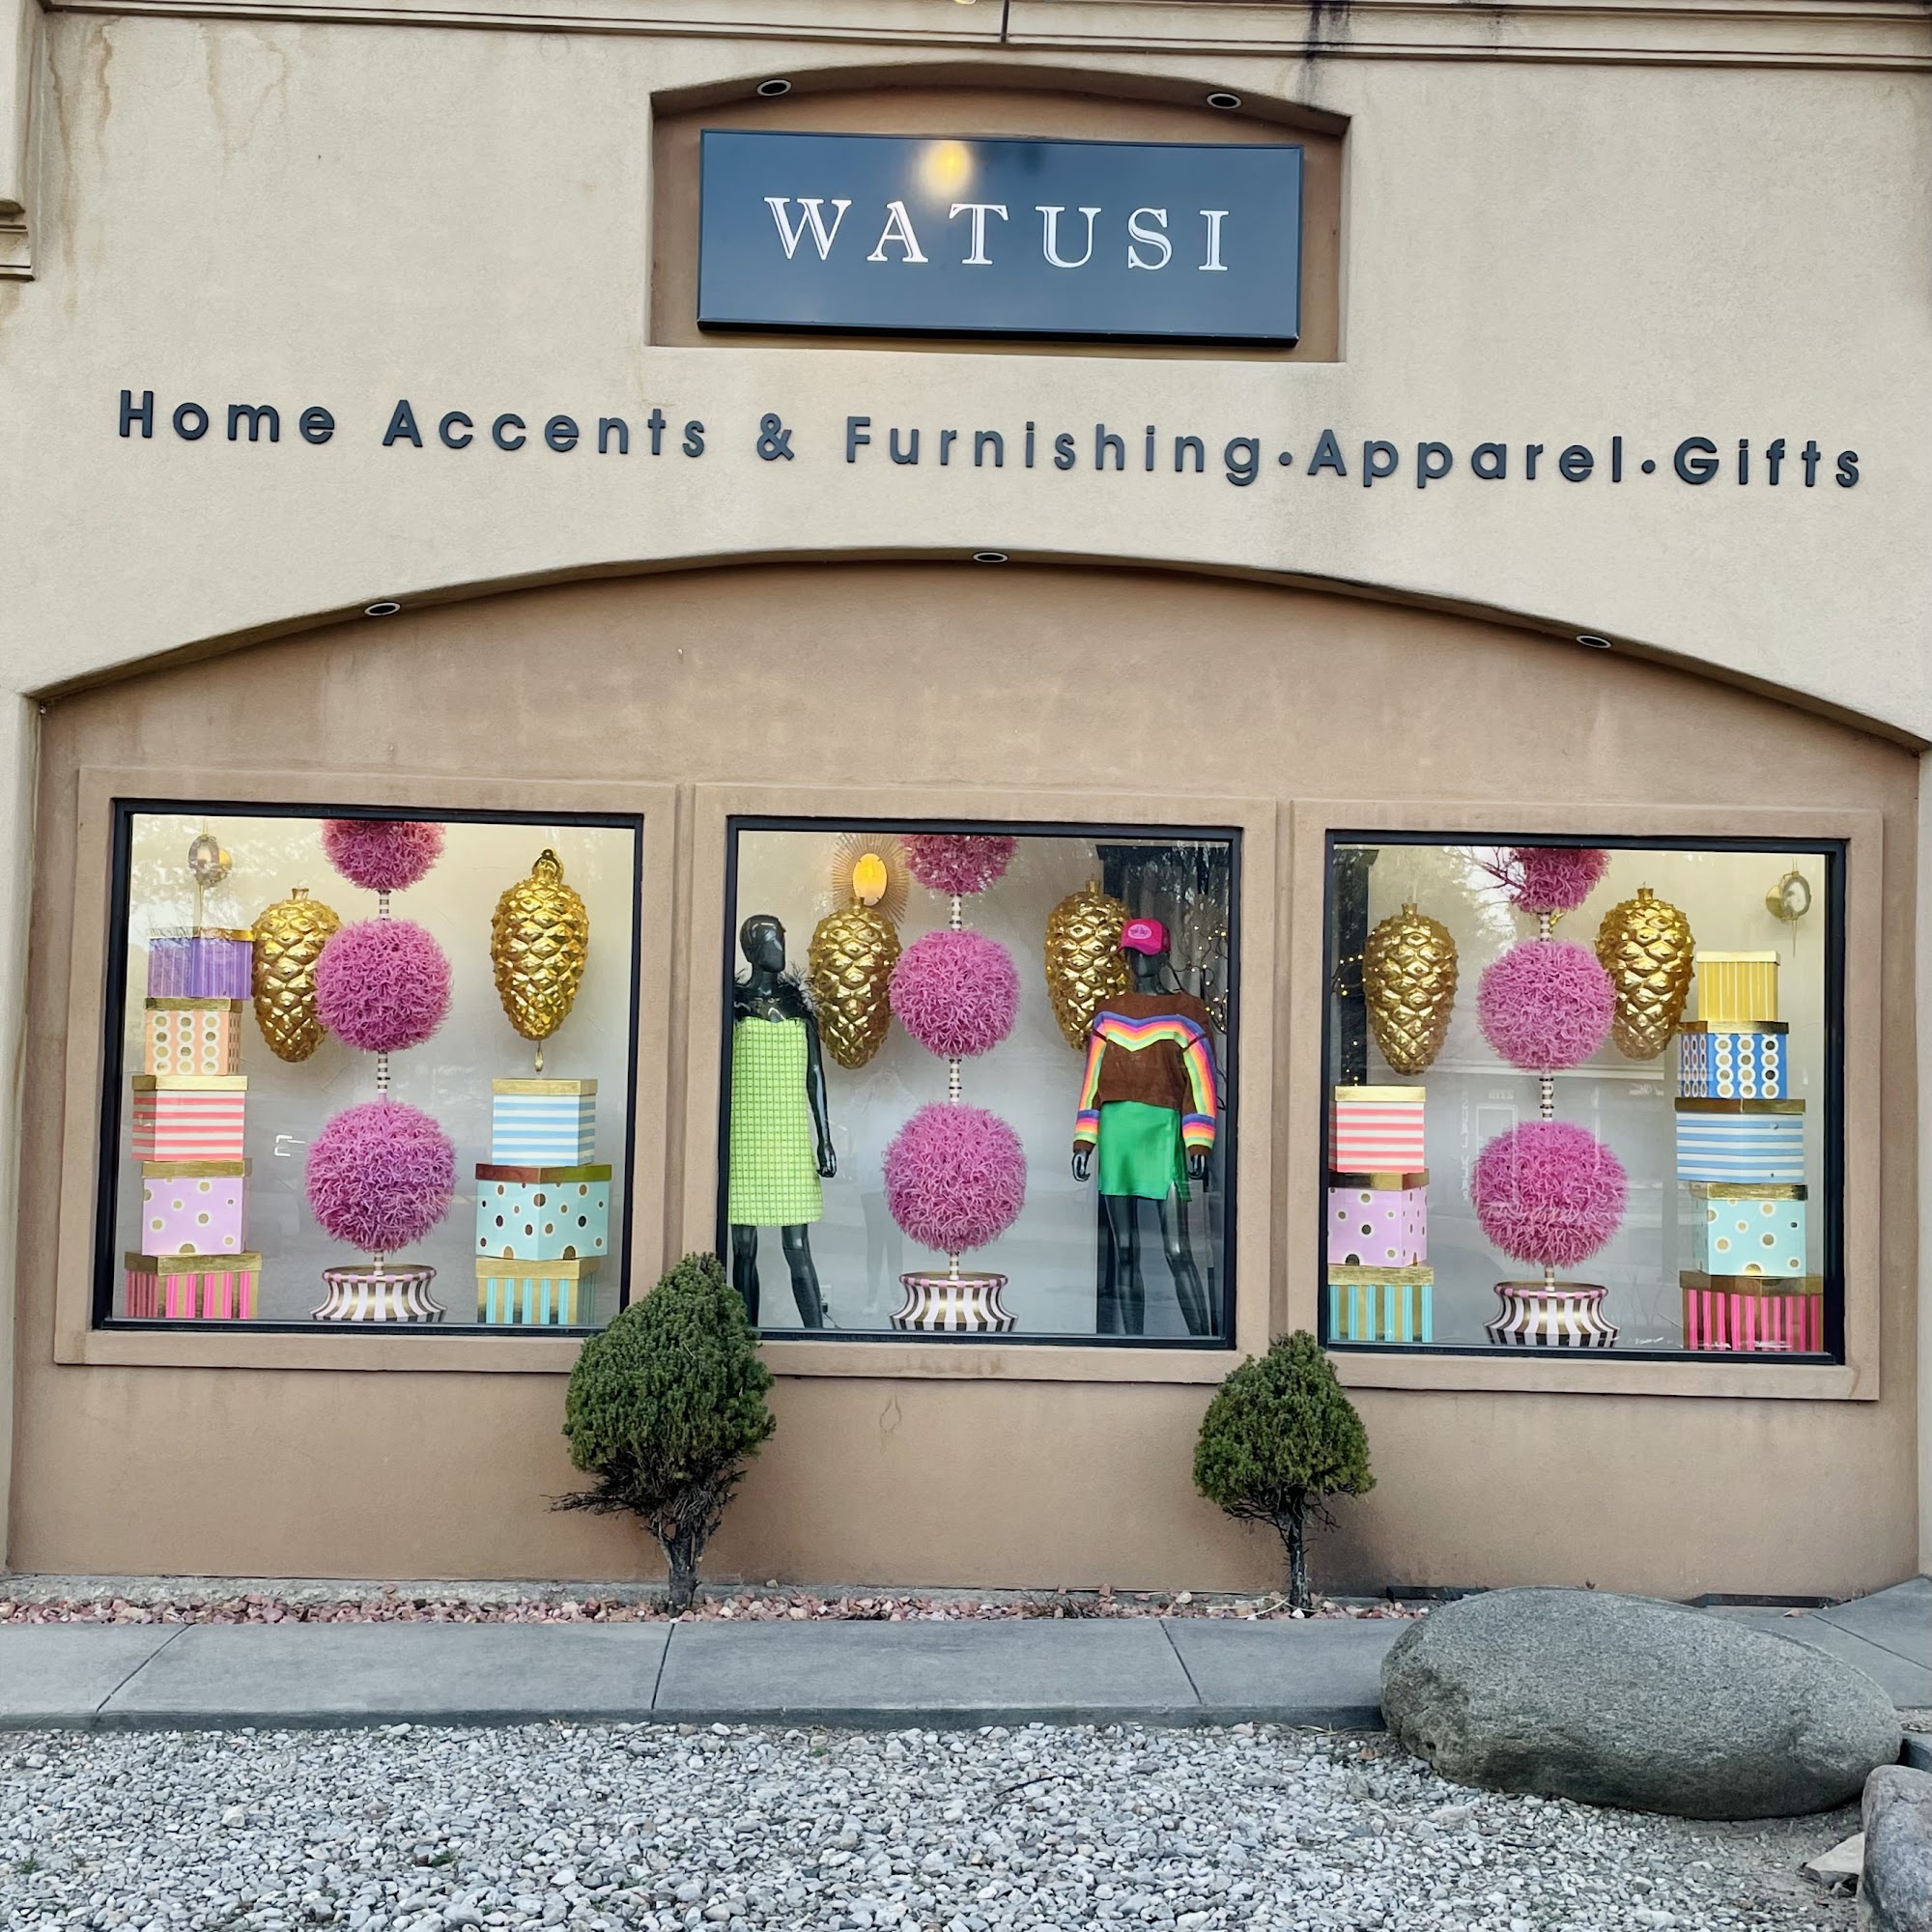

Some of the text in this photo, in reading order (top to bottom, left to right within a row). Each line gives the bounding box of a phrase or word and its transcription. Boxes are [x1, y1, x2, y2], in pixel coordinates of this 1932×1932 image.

[763, 196, 1230, 271] WATUSI
[119, 389, 336, 445] Home
[382, 399, 706, 458] Accents
[756, 412, 795, 462] &
